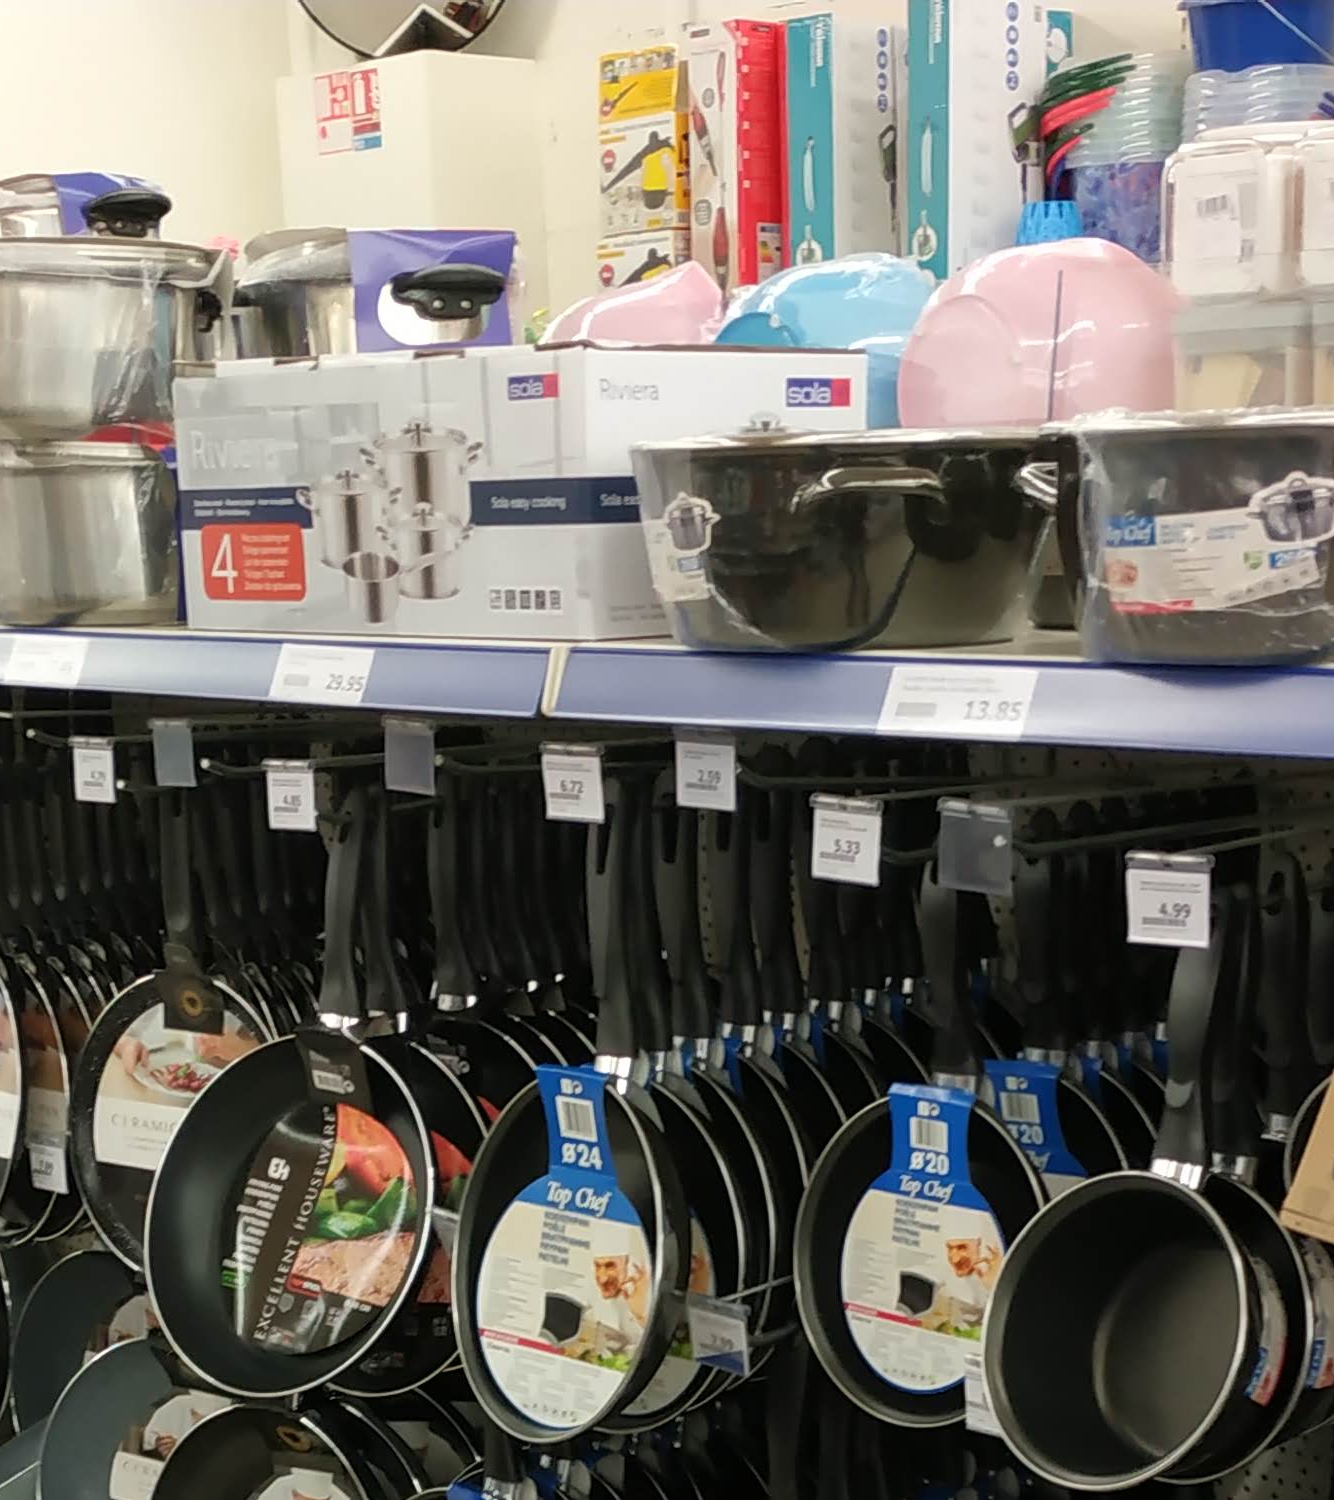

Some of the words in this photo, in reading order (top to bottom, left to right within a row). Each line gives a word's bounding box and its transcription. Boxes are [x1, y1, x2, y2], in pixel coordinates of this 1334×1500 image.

[508, 378, 545, 399] sola
[788, 381, 830, 405] sola
[211, 533, 239, 594] 4
[325, 673, 364, 693] 29.95
[963, 699, 1023, 722] 13.85
[834, 839, 861, 856] 5.33
[1159, 902, 1192, 919] 4.99
[561, 1142, 603, 1171] Ø24
[909, 1149, 950, 1176] Ø20
[546, 1180, 573, 1211] Top
[575, 1186, 611, 1218] Chef
[898, 1174, 920, 1199] Top
[921, 1178, 955, 1203] Chef
[253, 1237, 299, 1340] EXCELLENT
[294, 1112, 337, 1231] HOUSEWARE
